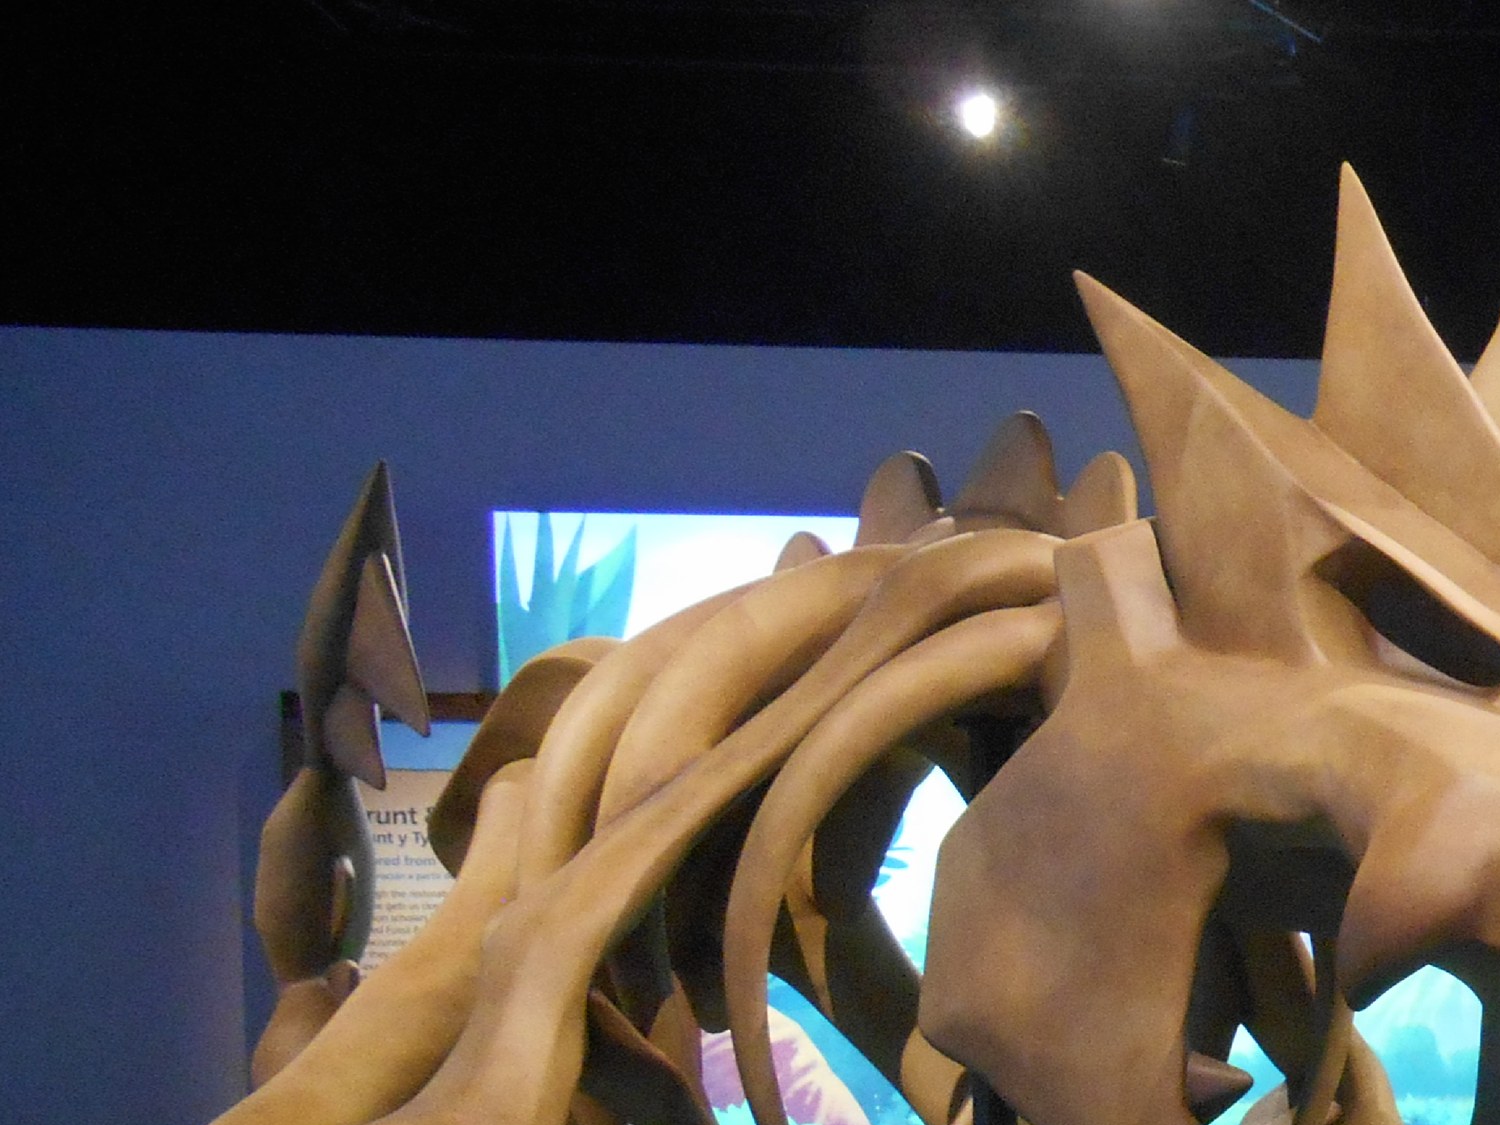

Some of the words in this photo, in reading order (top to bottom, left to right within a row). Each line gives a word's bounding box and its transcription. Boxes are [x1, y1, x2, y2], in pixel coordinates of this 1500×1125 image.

[398, 834, 407, 848] y
[412, 831, 428, 848] Ty
[404, 855, 436, 866] from
